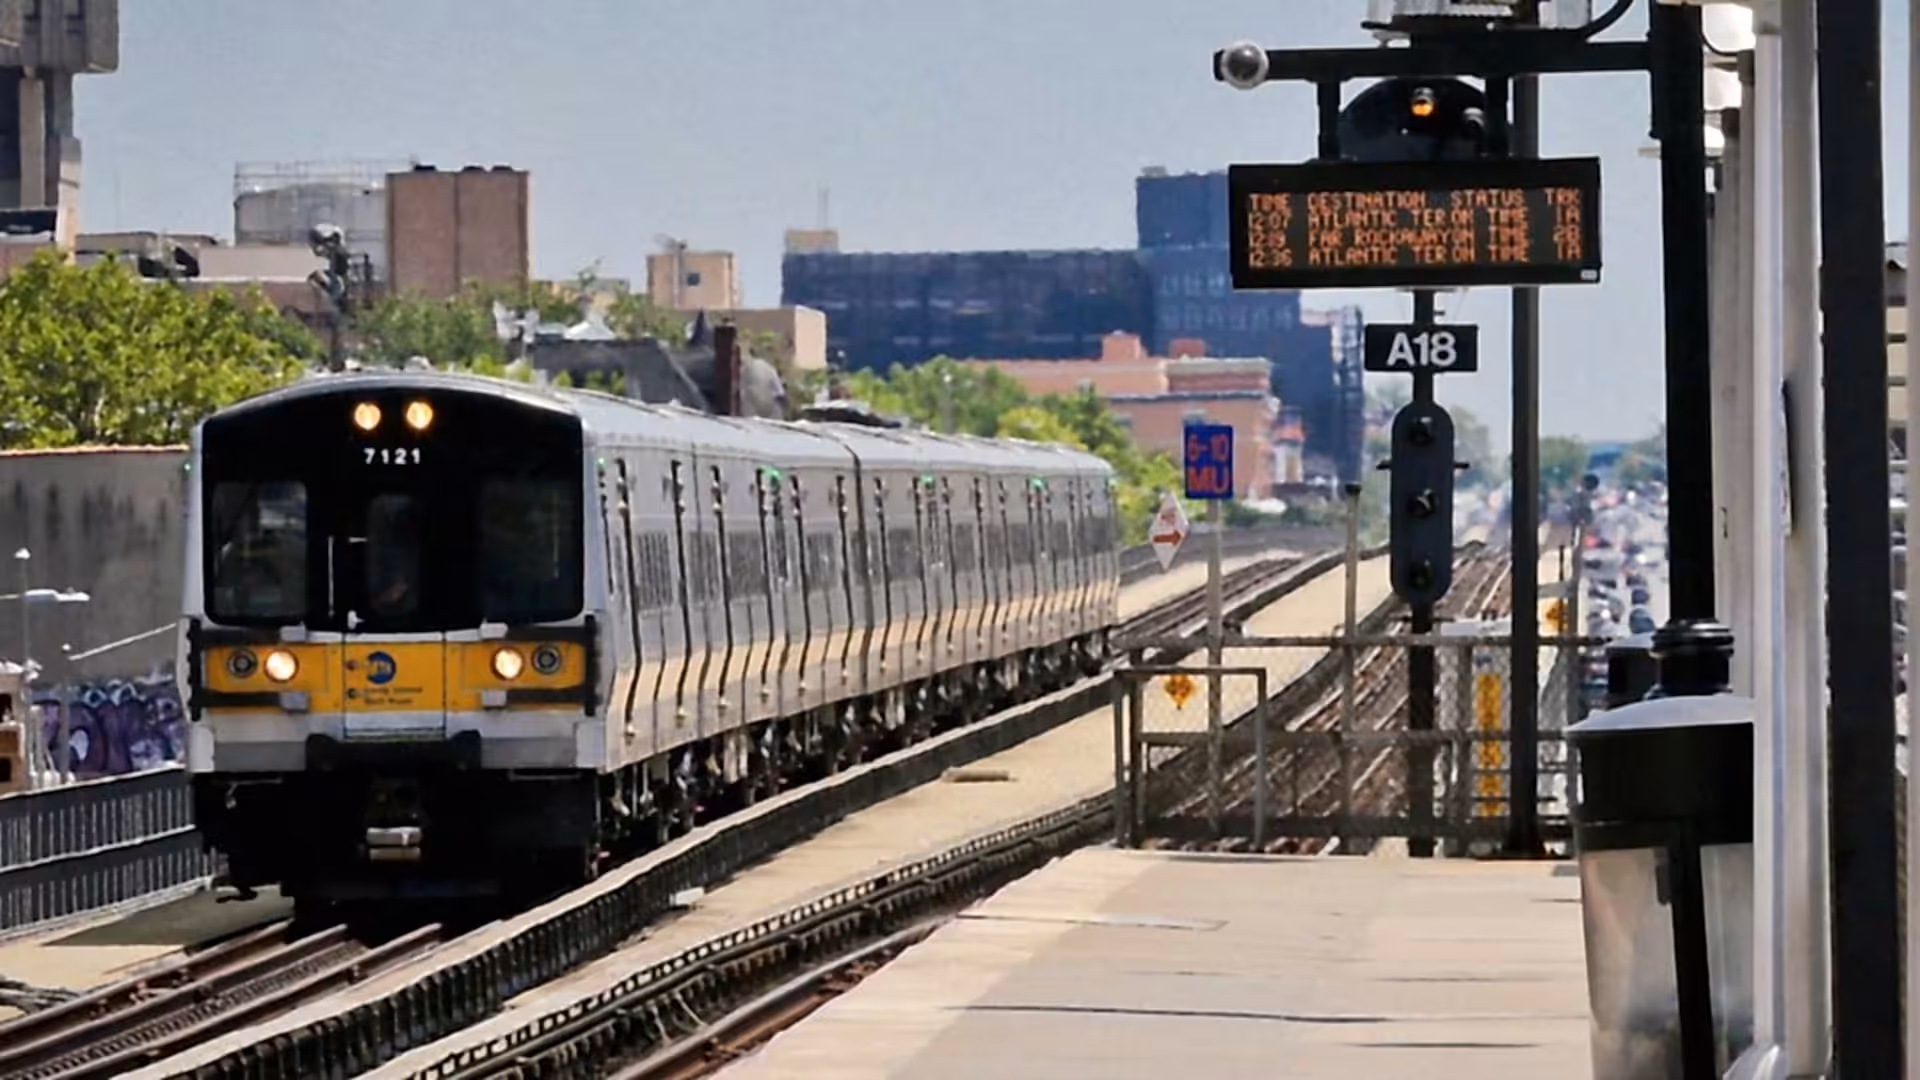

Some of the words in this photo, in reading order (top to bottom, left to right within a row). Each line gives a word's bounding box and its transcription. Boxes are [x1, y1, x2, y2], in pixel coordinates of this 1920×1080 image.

[1249, 193, 1290, 211] TIME
[1308, 191, 1425, 209] DESTINATION
[1451, 189, 1524, 206] STATUS
[1544, 188, 1579, 205] TRK
[1308, 209, 1397, 228] ATLANTIC
[1411, 208, 1446, 226] TER
[1451, 208, 1474, 224] ON
[1488, 207, 1528, 224] TIME
[1309, 229, 1344, 246] FAR
[1354, 227, 1450, 246] ROCKAWAY
[1488, 225, 1528, 243] TIME
[1309, 247, 1398, 265] ATLANTIC
[1412, 245, 1446, 264] TER
[1451, 245, 1475, 262] ON
[1488, 243, 1528, 262] TIME
[1386, 331, 1457, 367] A18
[363, 447, 421, 465] 7121
[1188, 466, 1229, 493] MU
